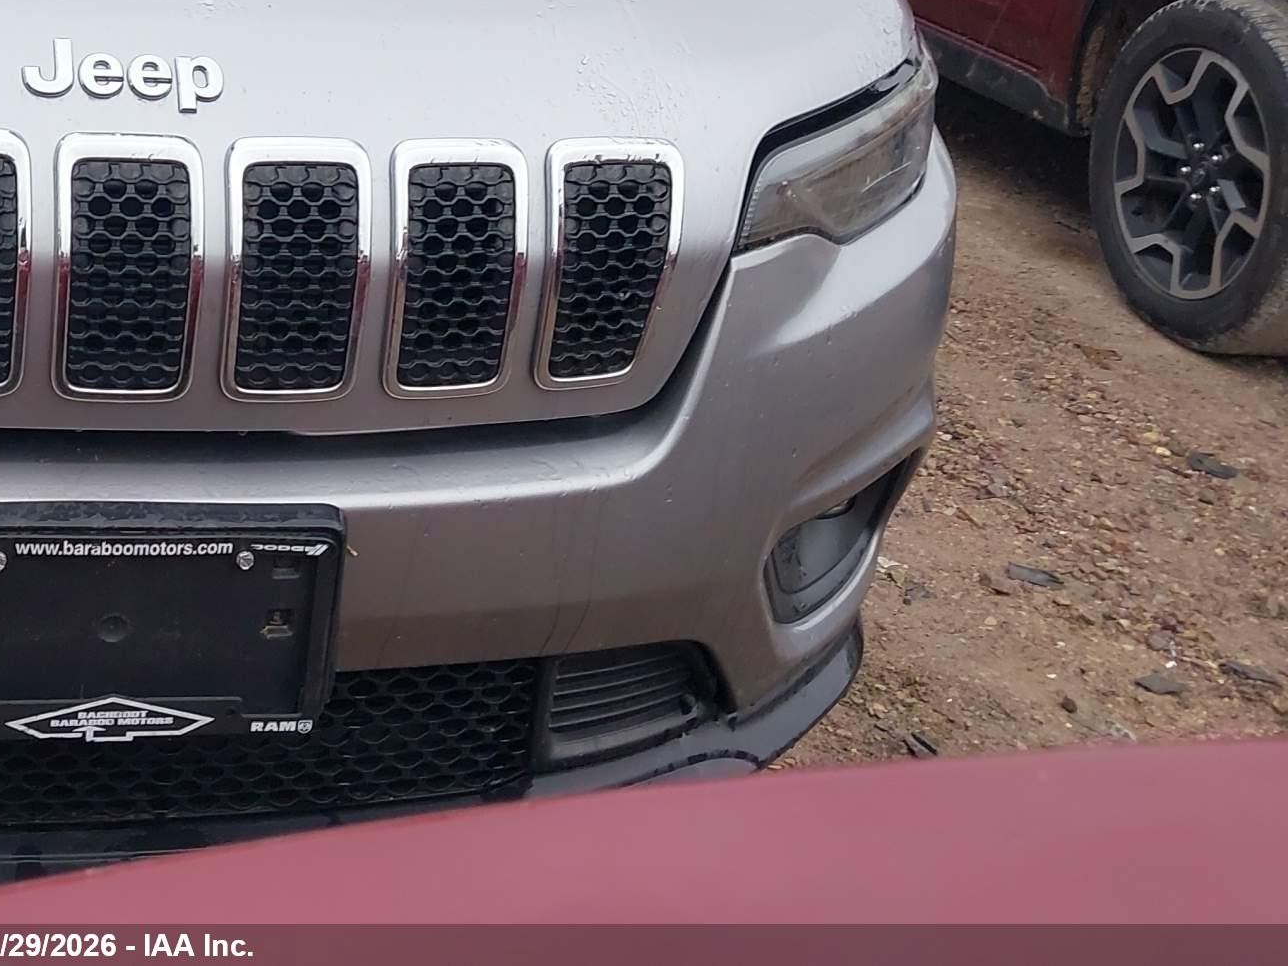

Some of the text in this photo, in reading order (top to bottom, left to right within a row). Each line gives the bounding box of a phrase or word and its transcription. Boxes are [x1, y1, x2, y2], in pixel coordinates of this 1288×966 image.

[22, 37, 224, 114] Jeep
[15, 540, 233, 556] www.baraboomotors.com
[250, 543, 317, 553] DODGE
[50, 717, 174, 728] BARABOO MOTORS
[250, 720, 297, 733] RAM
